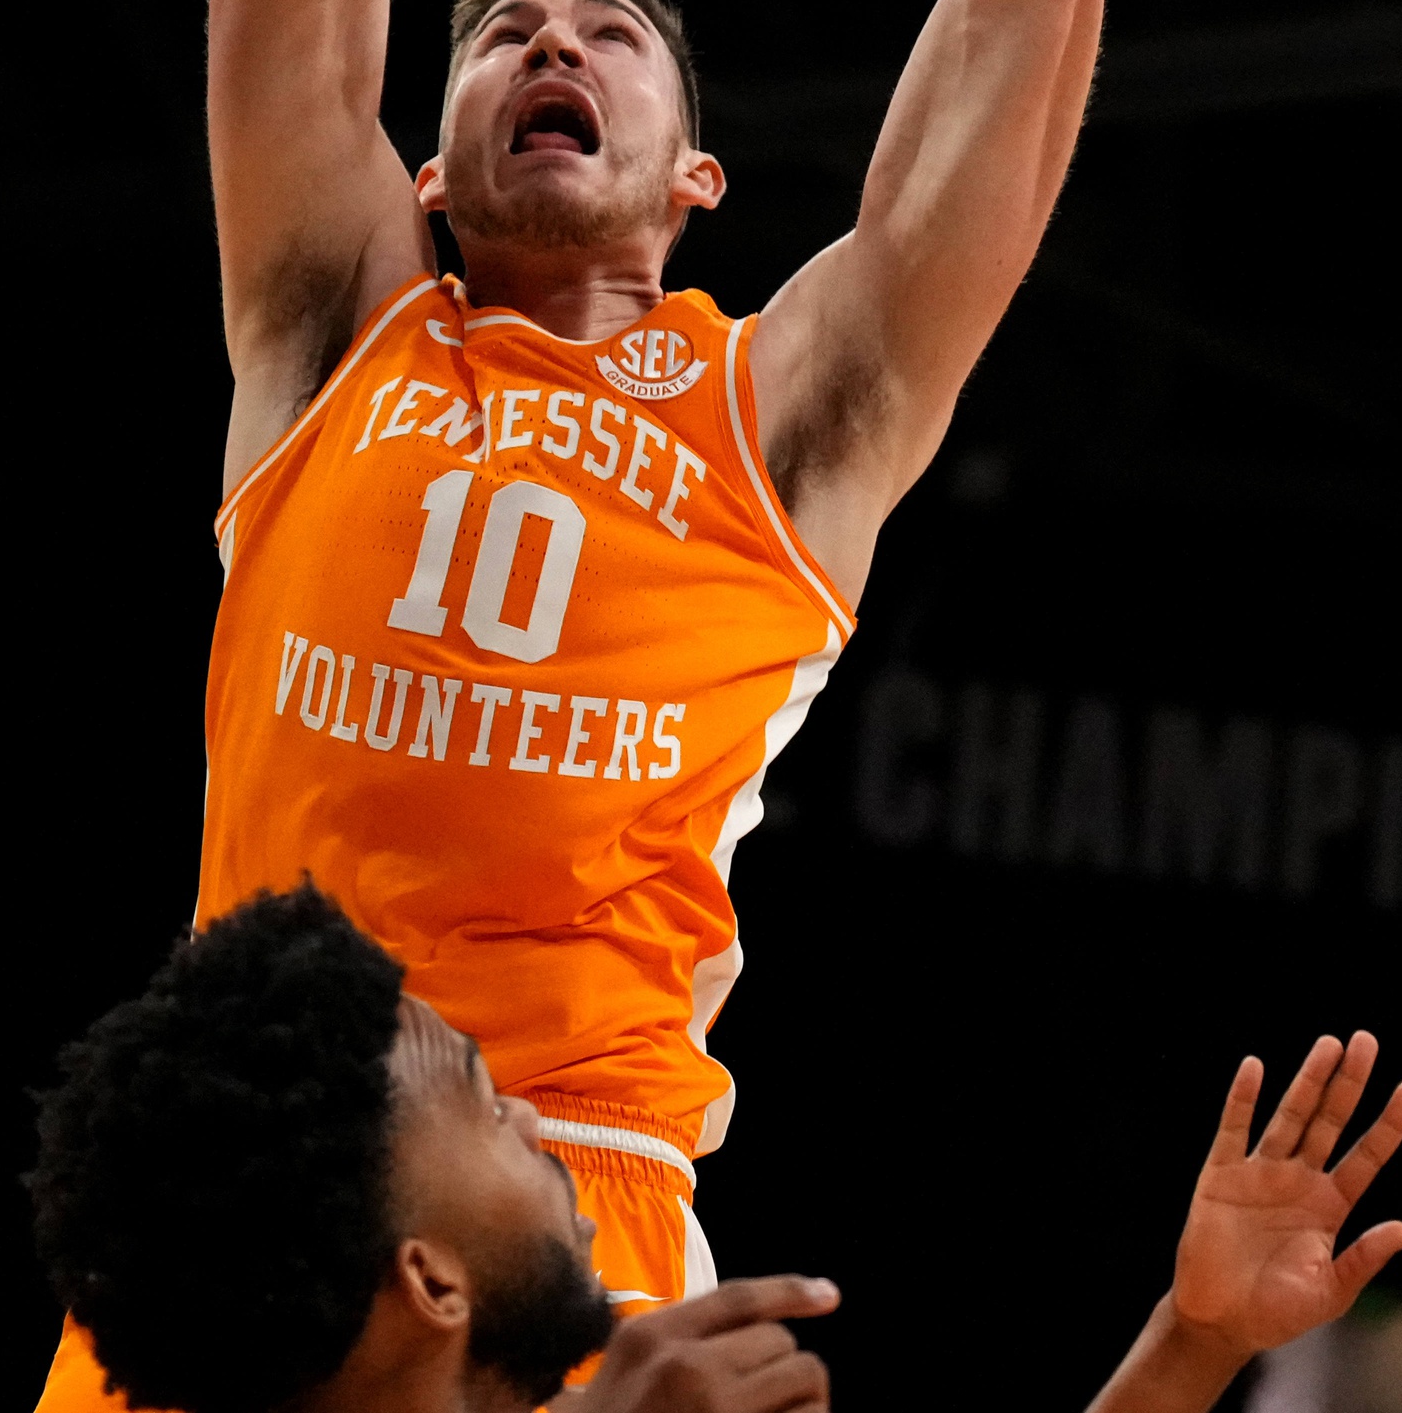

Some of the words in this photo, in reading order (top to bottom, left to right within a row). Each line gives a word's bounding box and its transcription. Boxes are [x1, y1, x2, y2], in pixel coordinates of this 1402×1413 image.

[606, 371, 694, 397] GRADUATE
[620, 329, 687, 379] SEC
[386, 469, 586, 664] 10
[274, 631, 686, 782] VOLUNTEERS
